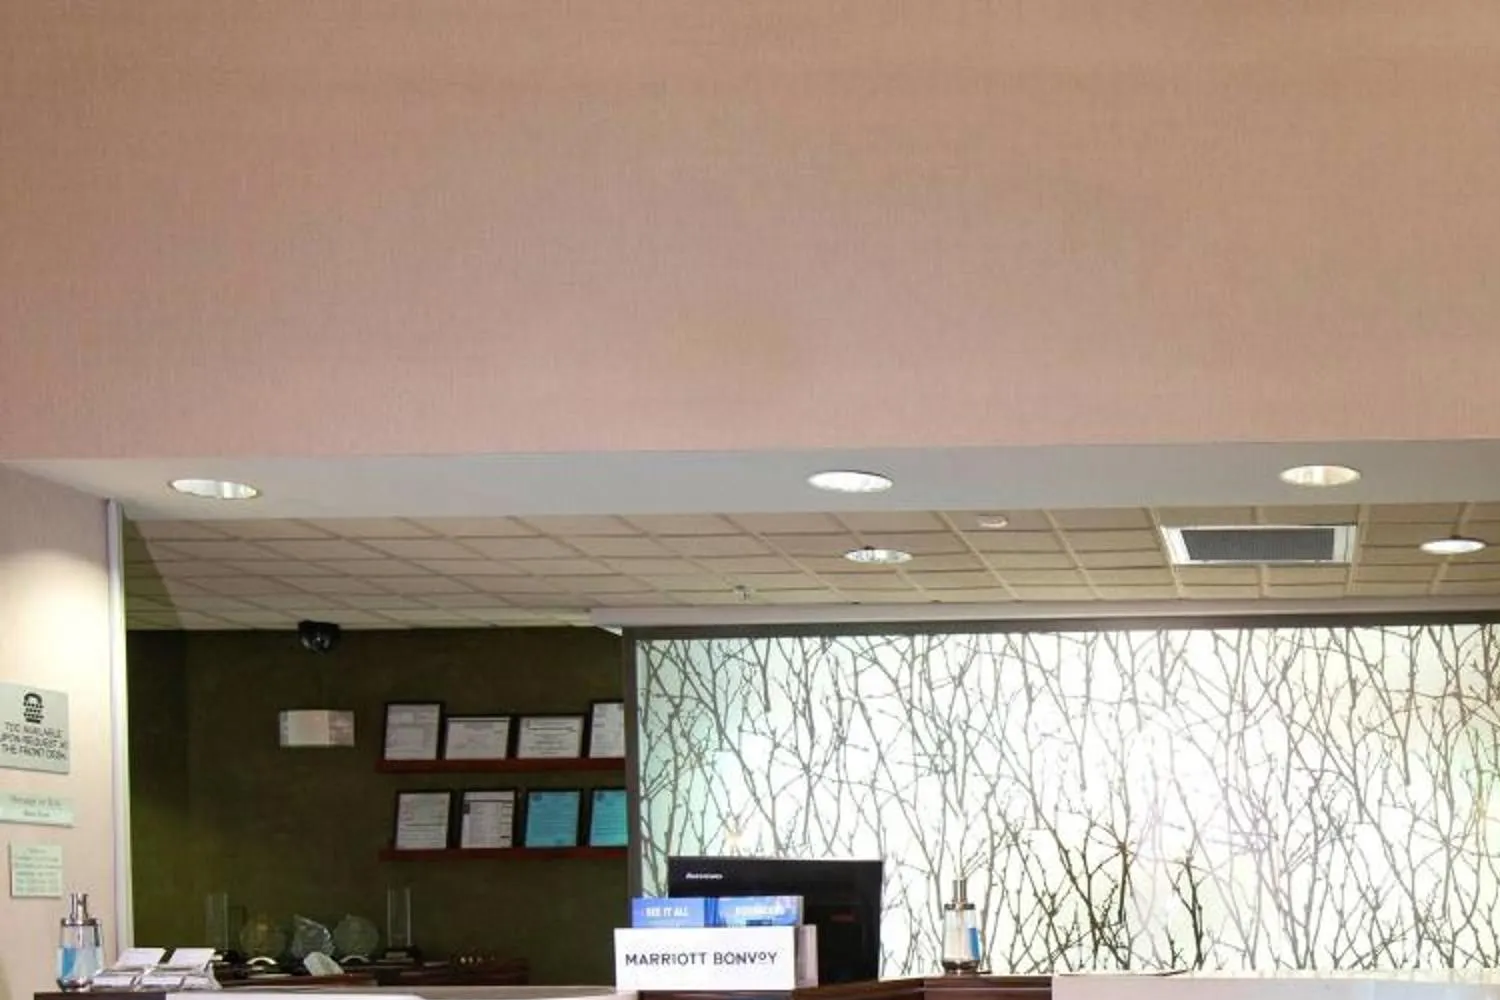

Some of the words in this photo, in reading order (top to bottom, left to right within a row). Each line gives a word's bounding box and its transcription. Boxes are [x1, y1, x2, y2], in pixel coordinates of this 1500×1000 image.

[663, 907, 672, 917] IT
[674, 906, 689, 917] ALL
[625, 952, 708, 966] MARRIOTT
[713, 951, 778, 965] BONVOY
